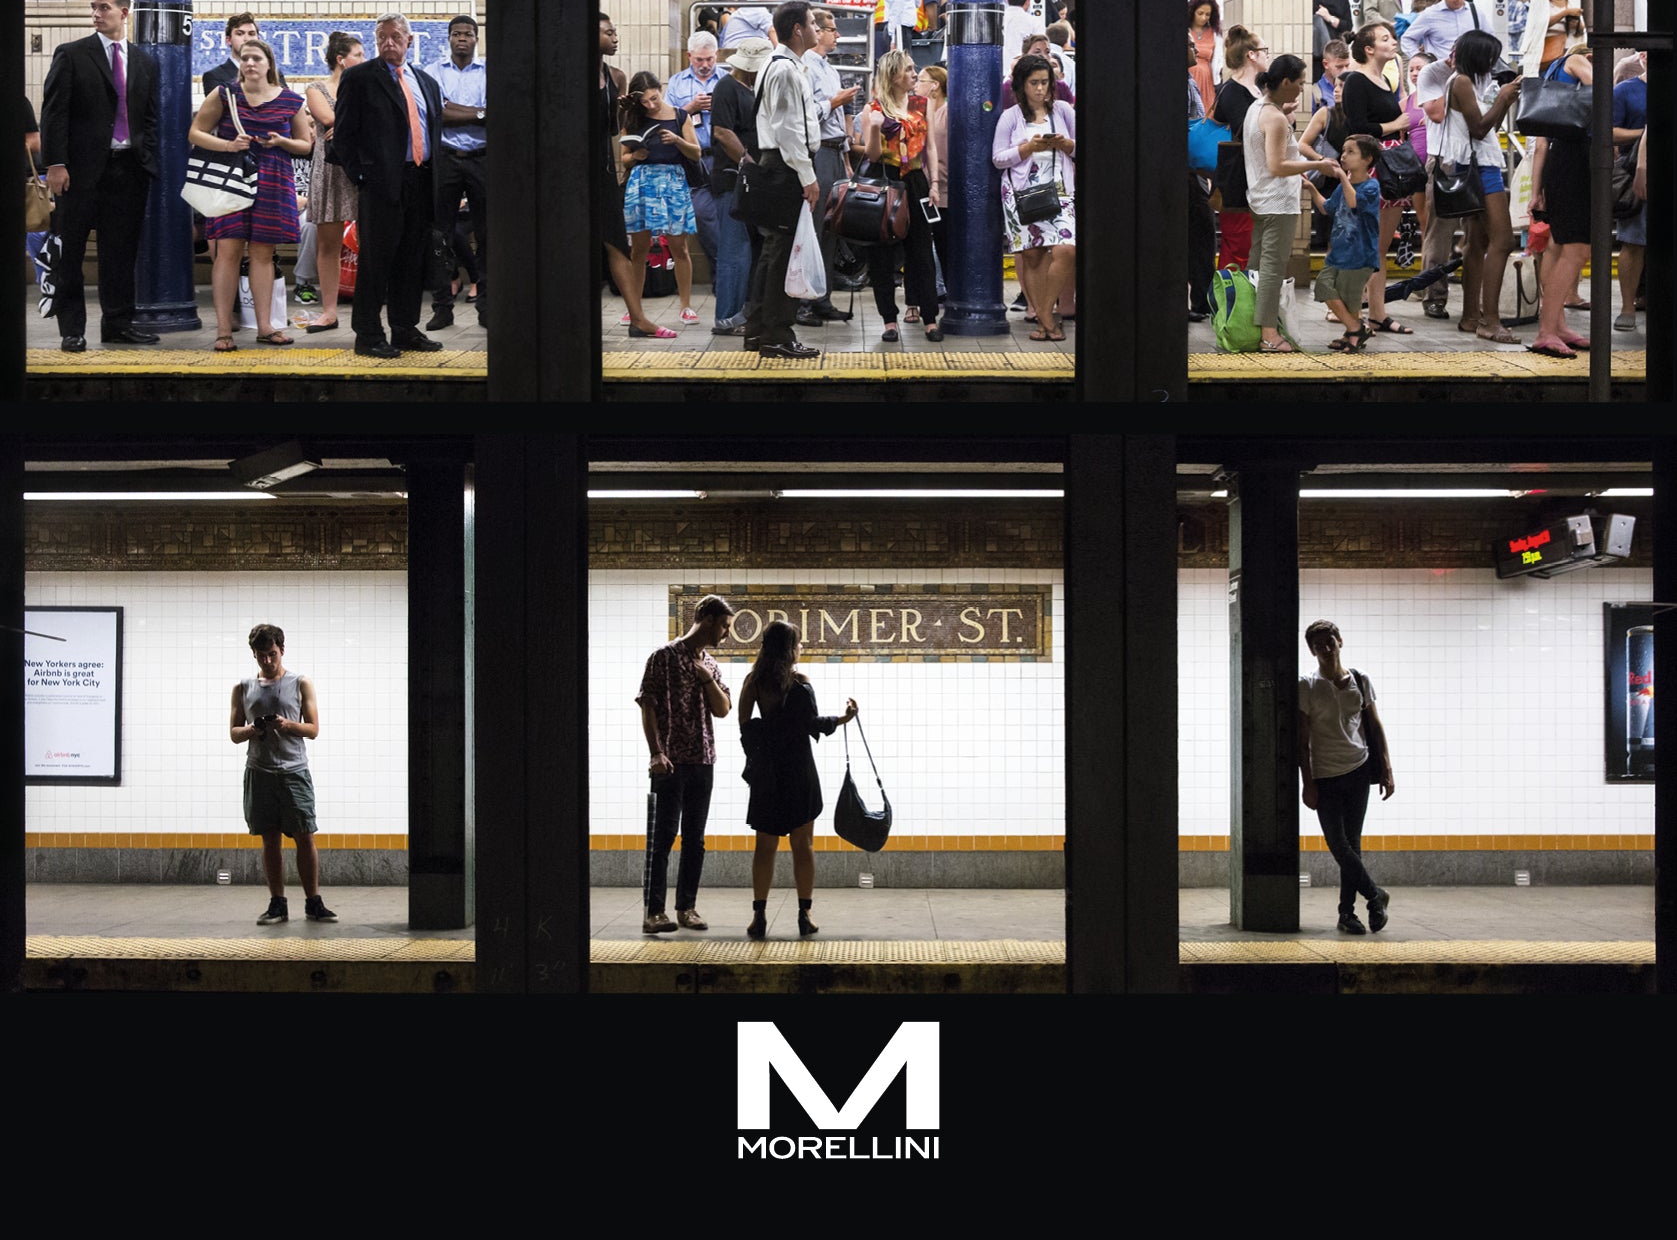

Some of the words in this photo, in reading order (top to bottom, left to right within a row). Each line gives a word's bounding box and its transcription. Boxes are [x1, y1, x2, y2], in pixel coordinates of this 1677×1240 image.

[957, 606, 1024, 644] ST.
[25, 660, 44, 668] New
[45, 660, 76, 668] Yorkers
[78, 662, 104, 670] agree:
[34, 669, 62, 677] Airbnb
[64, 669, 71, 677] is
[72, 670, 94, 679] great
[1629, 671, 1651, 685] Red
[27, 678, 39, 686] for
[41, 678, 60, 686] New
[82, 678, 101, 688] City
